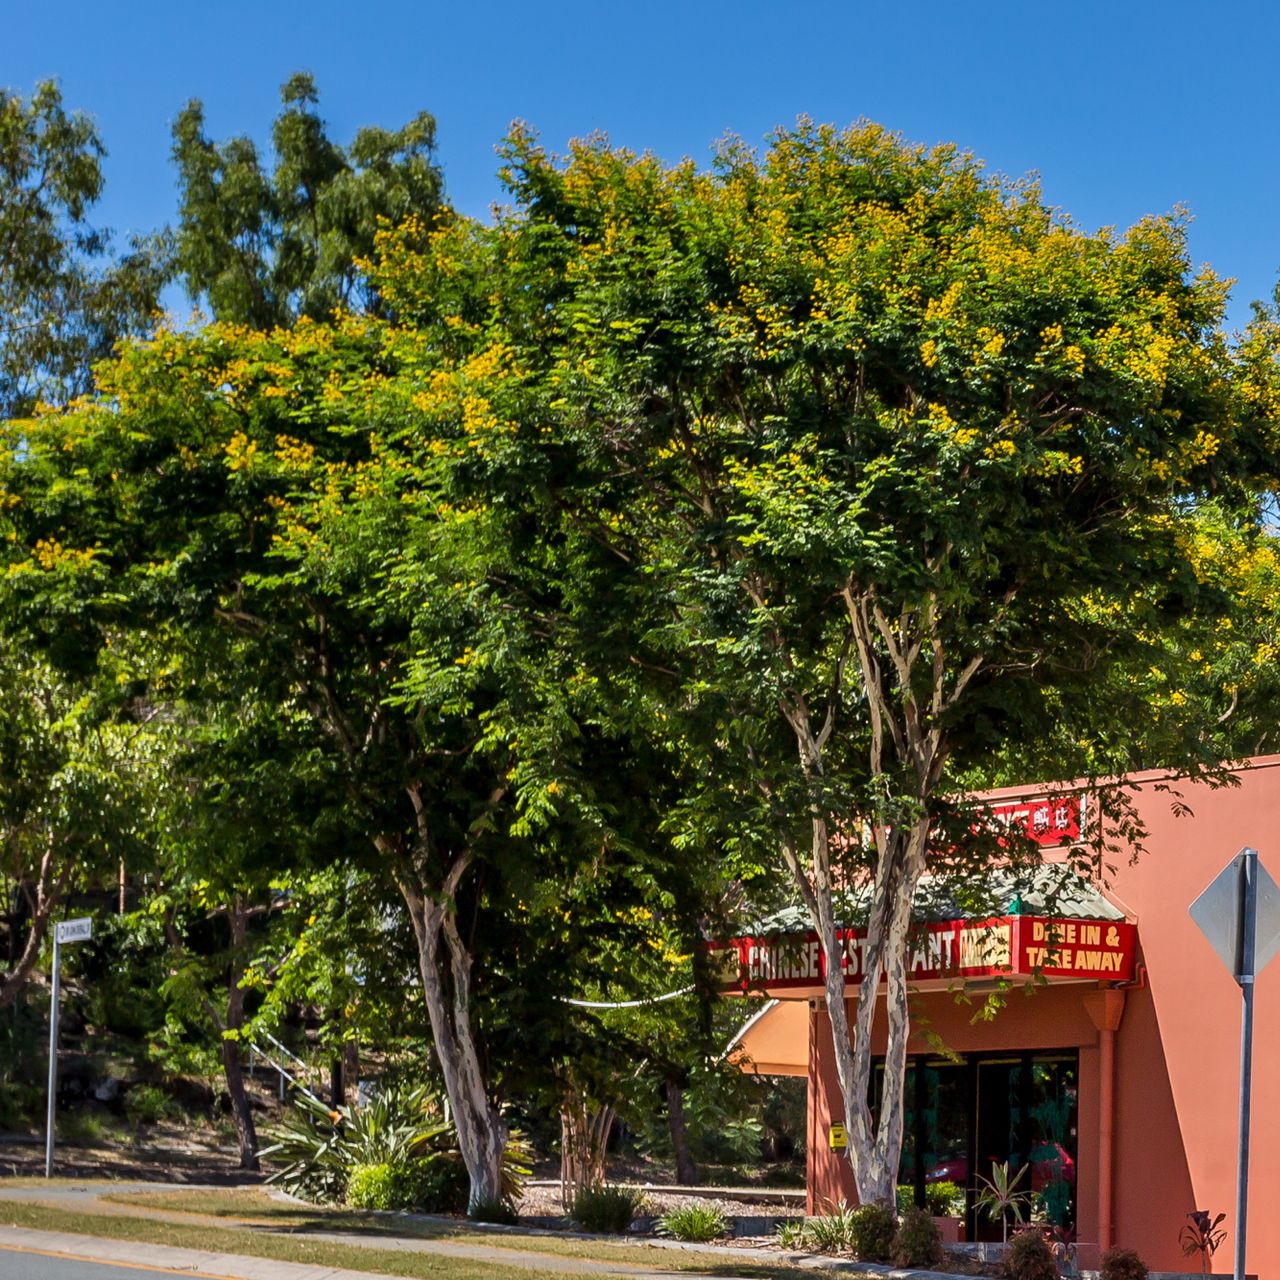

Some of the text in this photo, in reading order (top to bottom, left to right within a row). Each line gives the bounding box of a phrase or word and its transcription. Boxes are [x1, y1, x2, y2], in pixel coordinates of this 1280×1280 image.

[1080, 925, 1100, 945] IN
[1105, 926, 1120, 946] &
[749, 942, 819, 980] CHINESE
[1026, 947, 1072, 969] TAKE
[1074, 950, 1124, 972] AWAY
